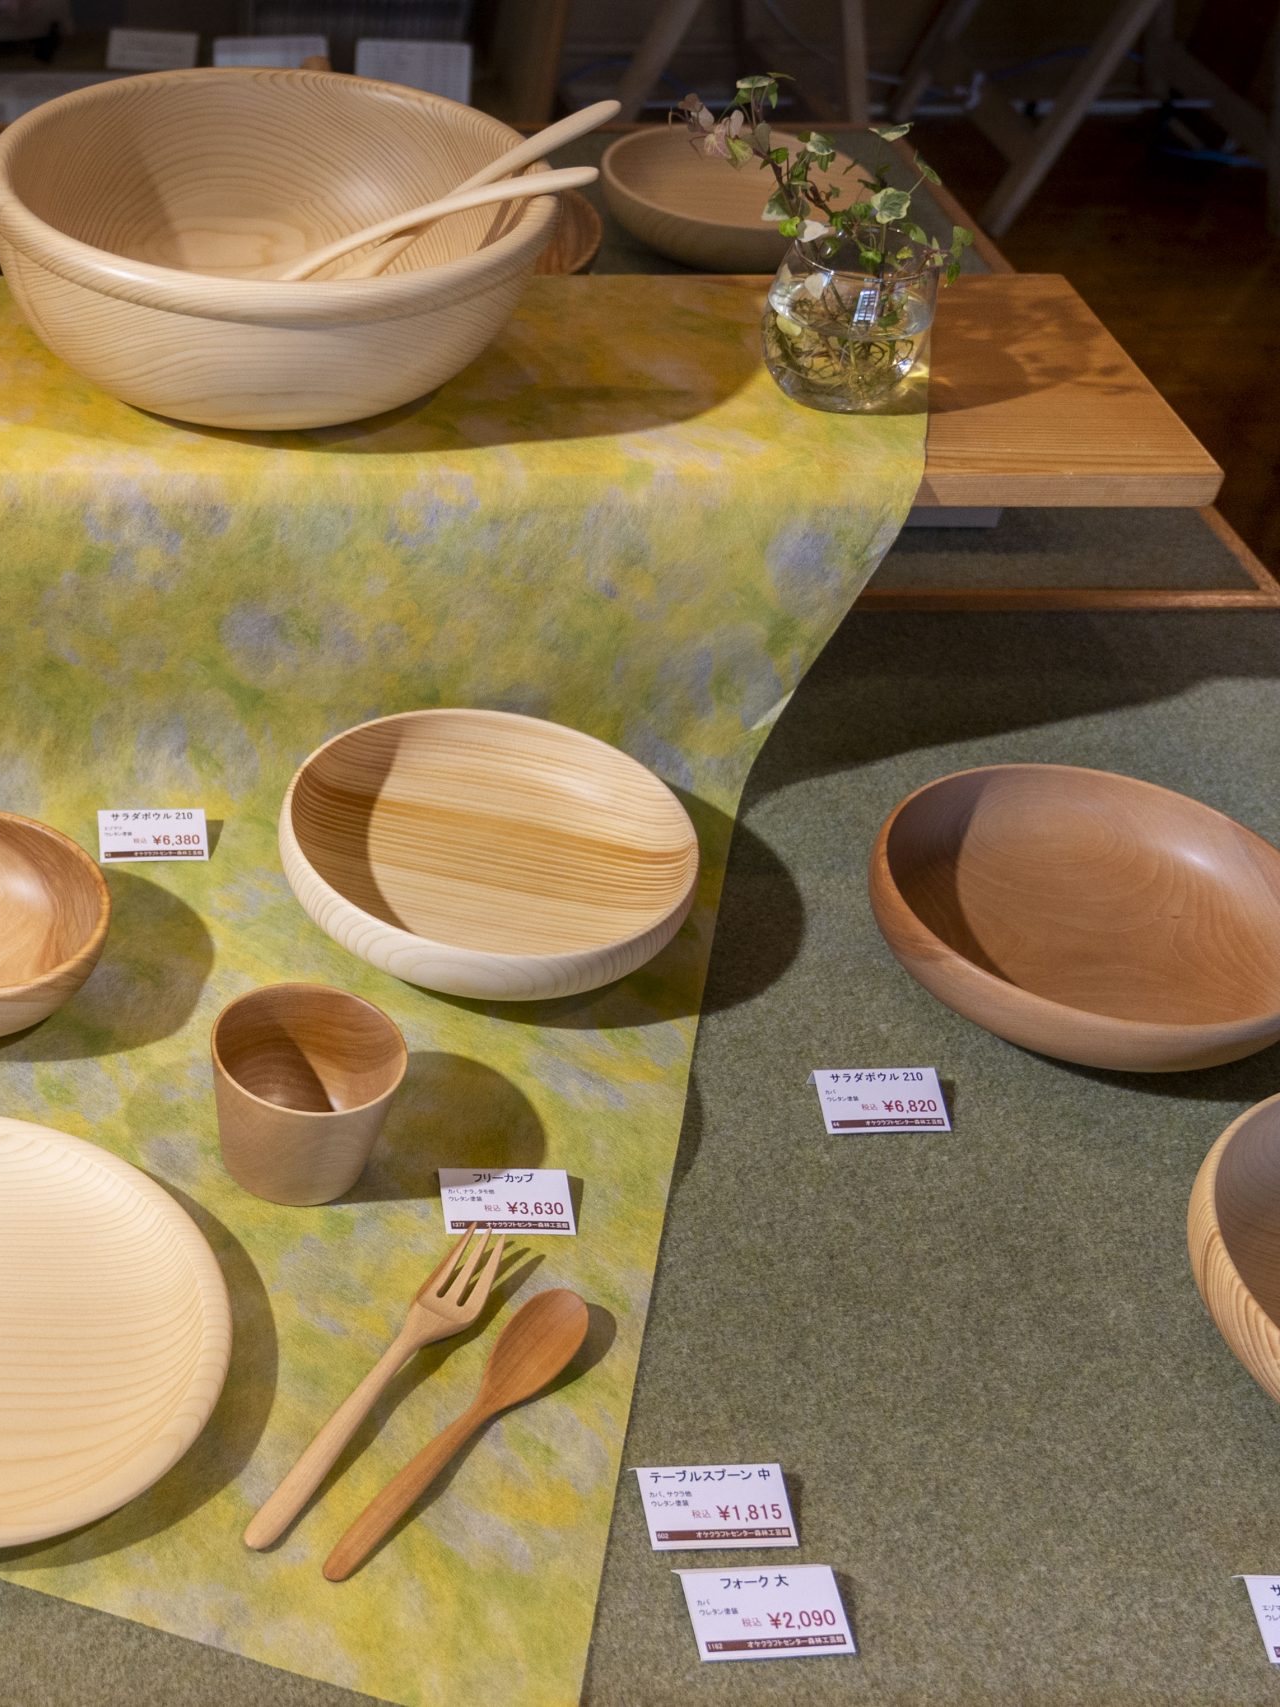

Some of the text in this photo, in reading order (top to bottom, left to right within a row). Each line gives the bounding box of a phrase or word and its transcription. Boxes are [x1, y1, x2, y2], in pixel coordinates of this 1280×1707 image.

[111, 812, 193, 821] サラダボウル 210
[152, 834, 200, 846] ¥6,380
[830, 1072, 923, 1083] サラダボウル 210
[882, 1100, 937, 1113] ¥6,820
[472, 1173, 535, 1183] フリーカップ
[484, 1202, 564, 1216] 税込 ¥3,630
[649, 1468, 770, 1483] テーブルスプーン 中
[692, 1504, 782, 1522] 税込 ¥1,815
[720, 1574, 789, 1589] フォーク 大
[699, 1608, 738, 1616] ウレタン塗装
[742, 1609, 836, 1630] 税込 ¥2,090
